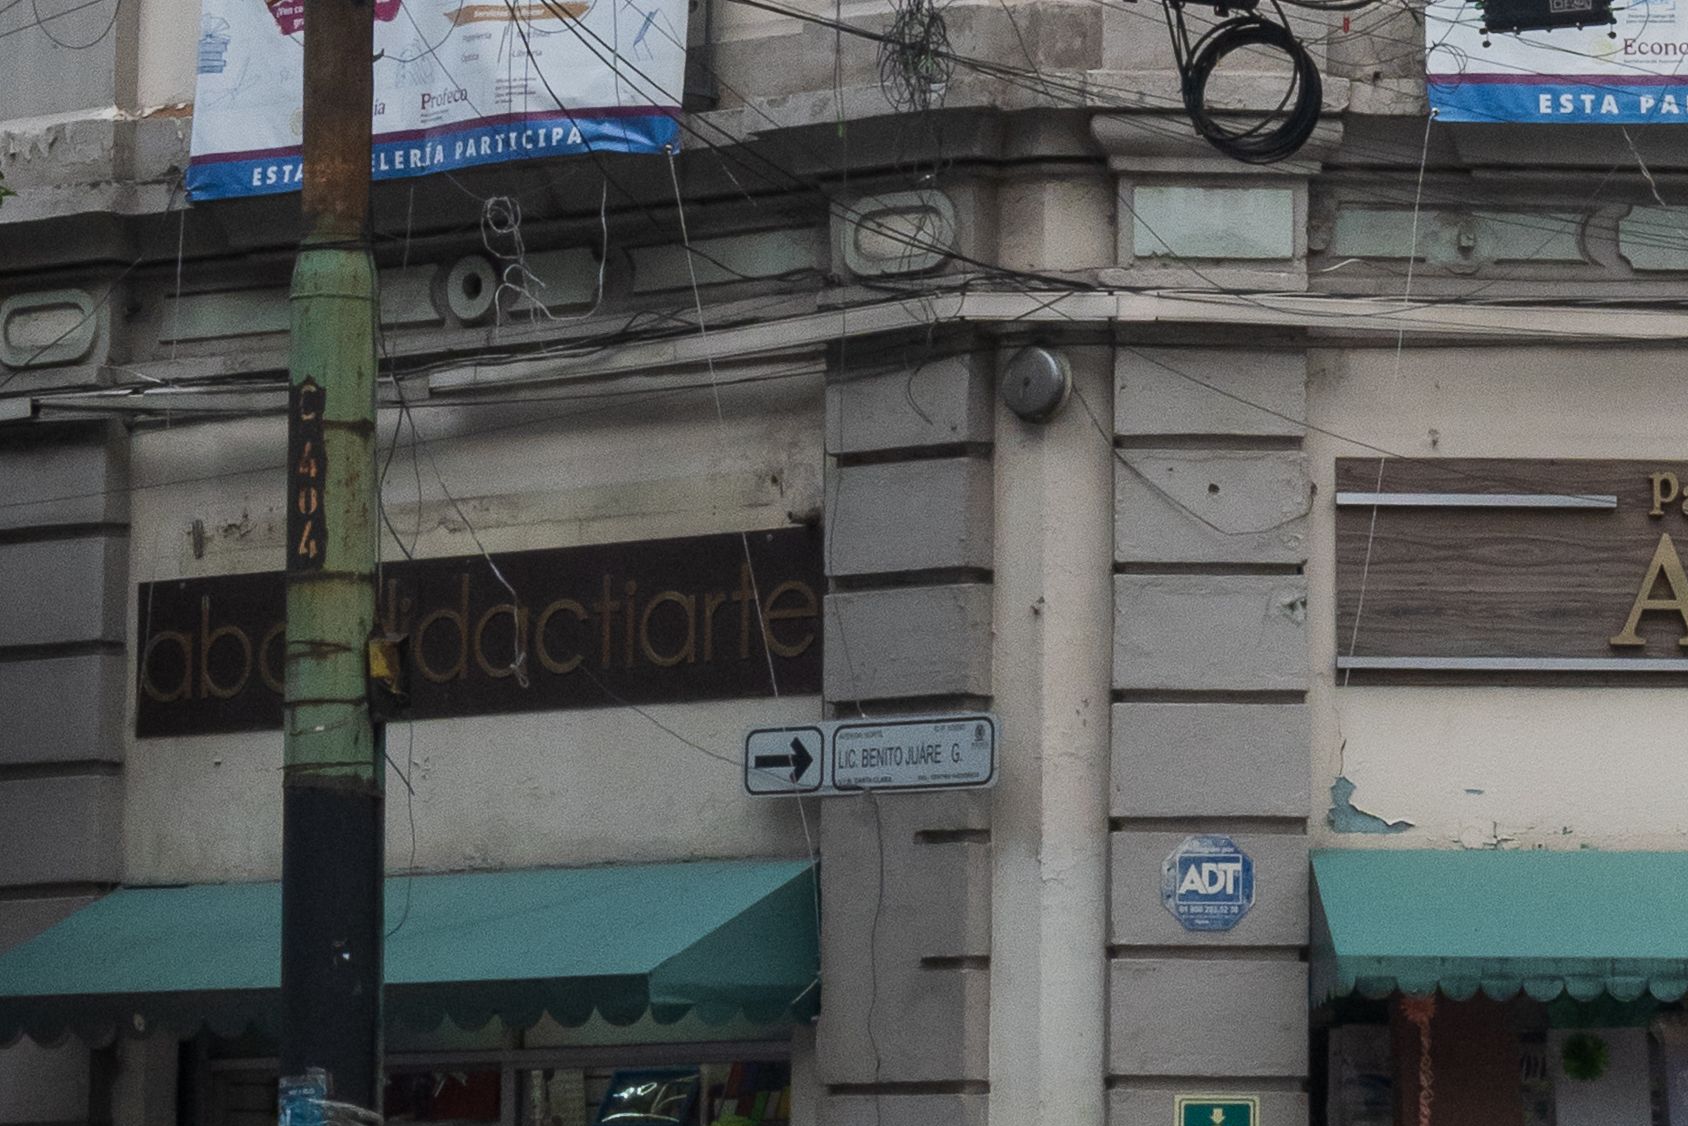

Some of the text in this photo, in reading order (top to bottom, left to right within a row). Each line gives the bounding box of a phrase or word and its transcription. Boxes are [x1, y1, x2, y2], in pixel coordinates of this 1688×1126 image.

[421, 87, 468, 110] Profeco
[1539, 93, 1620, 115] ESTA
[454, 126, 583, 160] PARTICIPA
[838, 748, 858, 769] LIC.
[861, 746, 903, 769] BENITO
[1178, 862, 1241, 895] ADT
